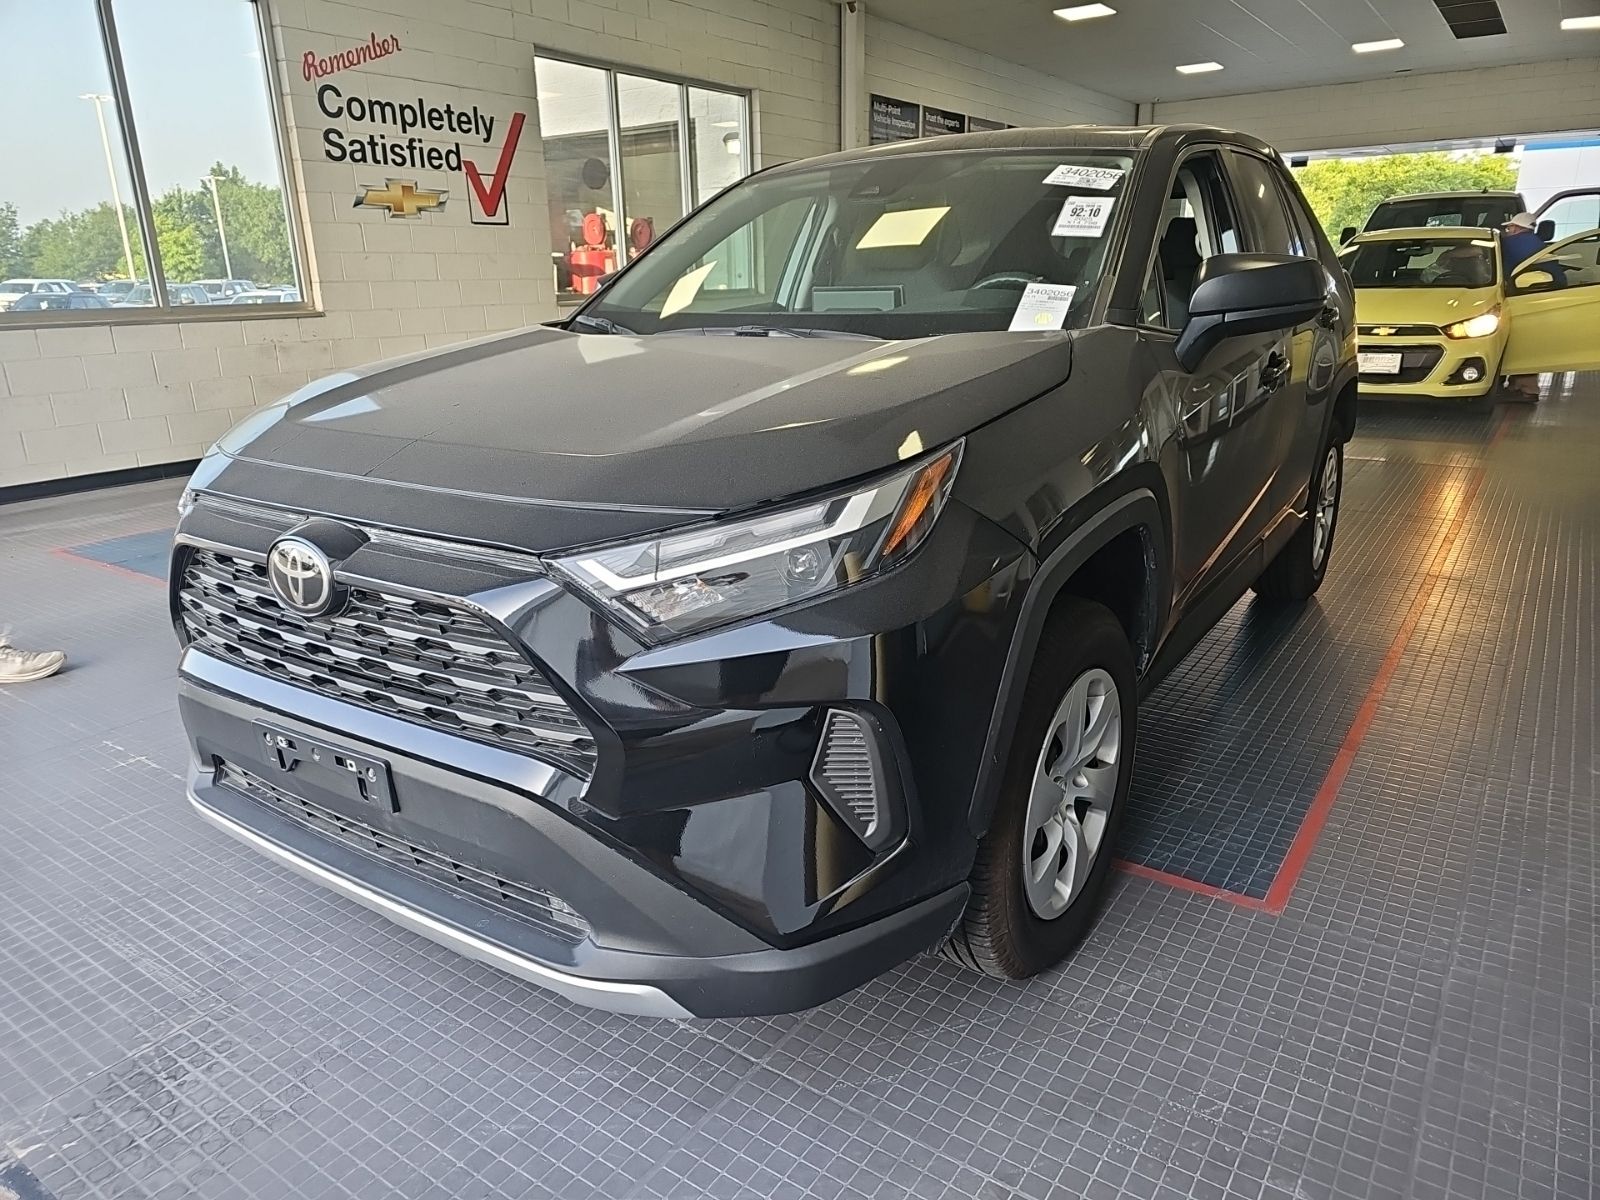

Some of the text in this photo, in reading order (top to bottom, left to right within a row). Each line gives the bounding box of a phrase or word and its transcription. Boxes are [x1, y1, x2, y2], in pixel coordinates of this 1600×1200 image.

[303, 32, 401, 81] Remember
[318, 84, 494, 143] Completely
[873, 101, 901, 115] Multi-Point
[873, 113, 891, 124] Vehicle
[892, 117, 916, 129] Inspection
[925, 112, 936, 122] Trust
[944, 118, 960, 128] experts
[323, 128, 462, 171] Satisfied
[1061, 167, 1122, 180] 3402056
[1070, 207, 1101, 217] 92:10
[1027, 288, 1073, 298] 3402056
